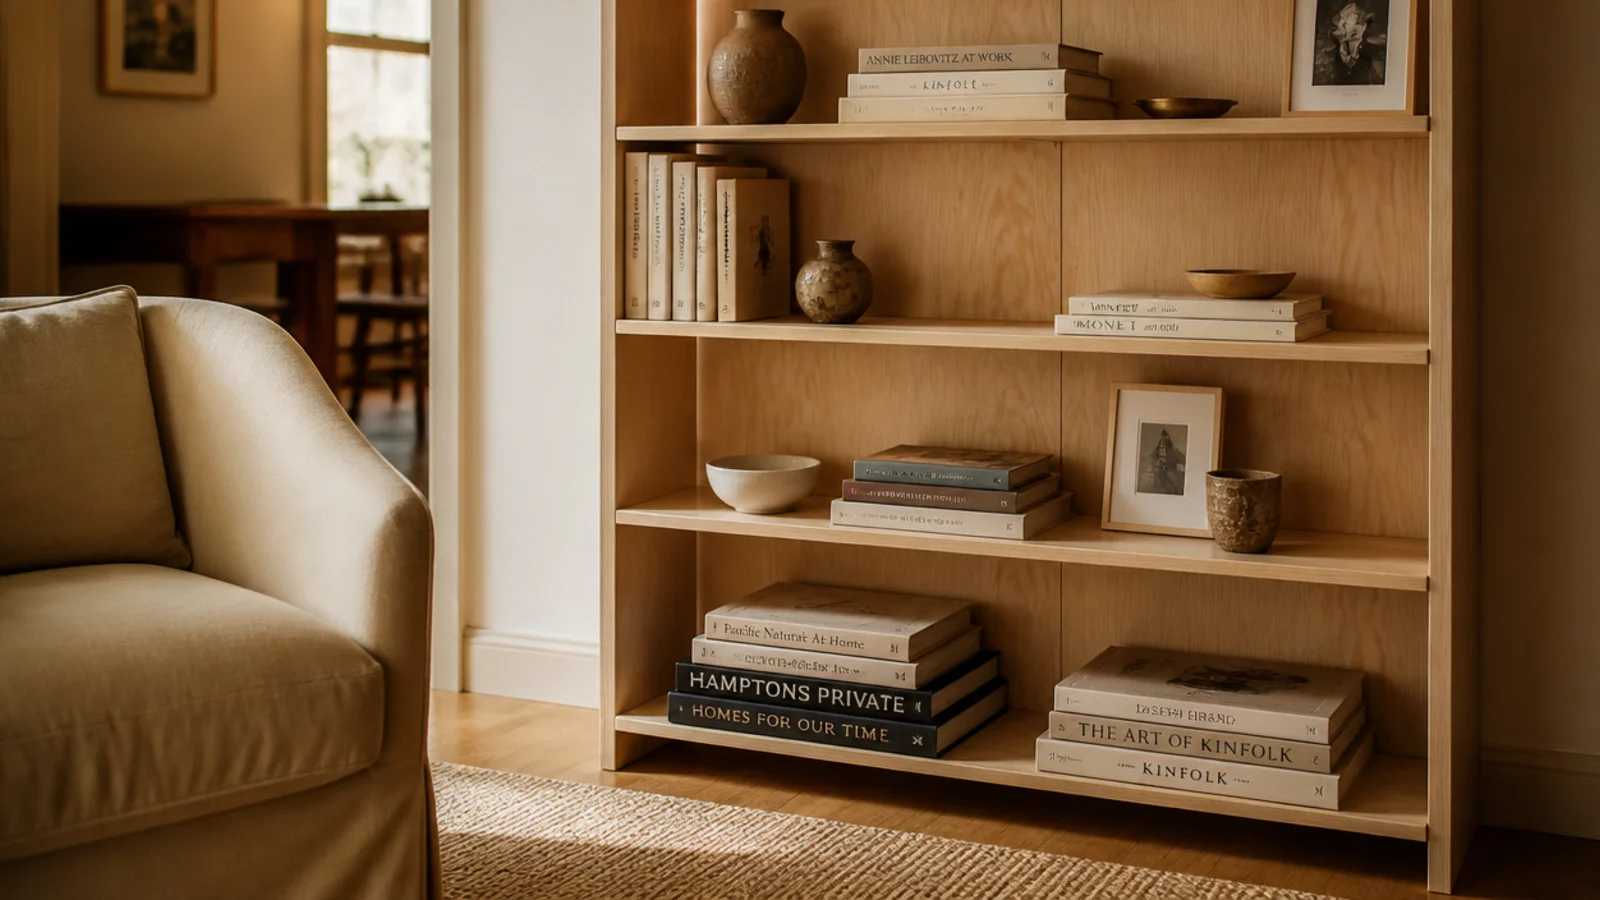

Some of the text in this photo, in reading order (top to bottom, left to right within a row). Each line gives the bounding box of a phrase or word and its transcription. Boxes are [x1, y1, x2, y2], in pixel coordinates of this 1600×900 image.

[866, 52, 1013, 65] ANNIE LEIBOVITZ AT WORK
[812, 633, 827, 645] At
[690, 672, 905, 713] HAMPTONS PRIVATE
[692, 704, 889, 743] HOMES FOR OUR TIME
[1078, 722, 1293, 763] THE ART OF KINFOLK
[1143, 762, 1228, 785] KINFOLK
